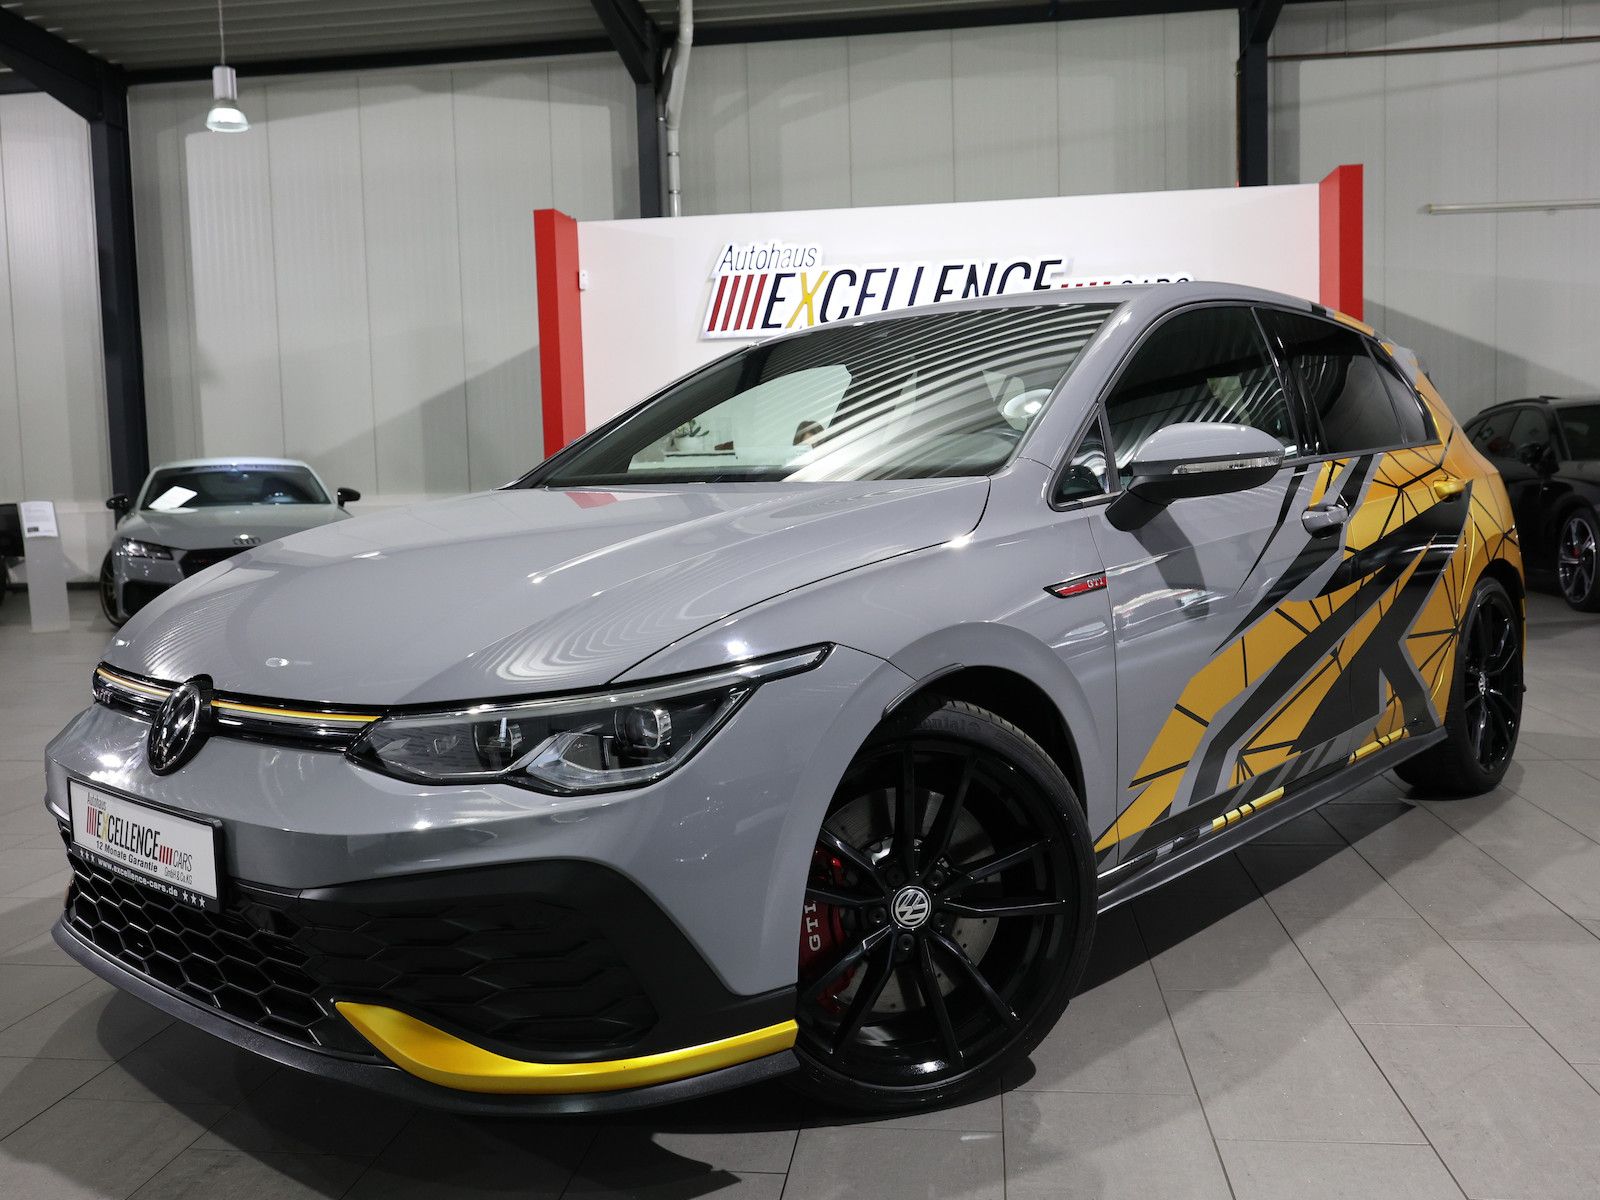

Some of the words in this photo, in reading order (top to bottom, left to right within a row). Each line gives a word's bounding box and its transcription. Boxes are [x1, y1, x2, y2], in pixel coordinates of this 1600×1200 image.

[718, 243, 818, 272] Autohaus
[761, 259, 1063, 329] EXCELLENCE
[1086, 577, 1105, 588] GTI
[96, 810, 161, 861] EXCELLENCE
[173, 850, 193, 873] CARS
[96, 840, 103, 849] 12
[105, 843, 127, 860] Monate
[128, 853, 158, 873] Garantie
[97, 858, 179, 897] www.excellence-cars.de
[804, 902, 821, 952] GTI
